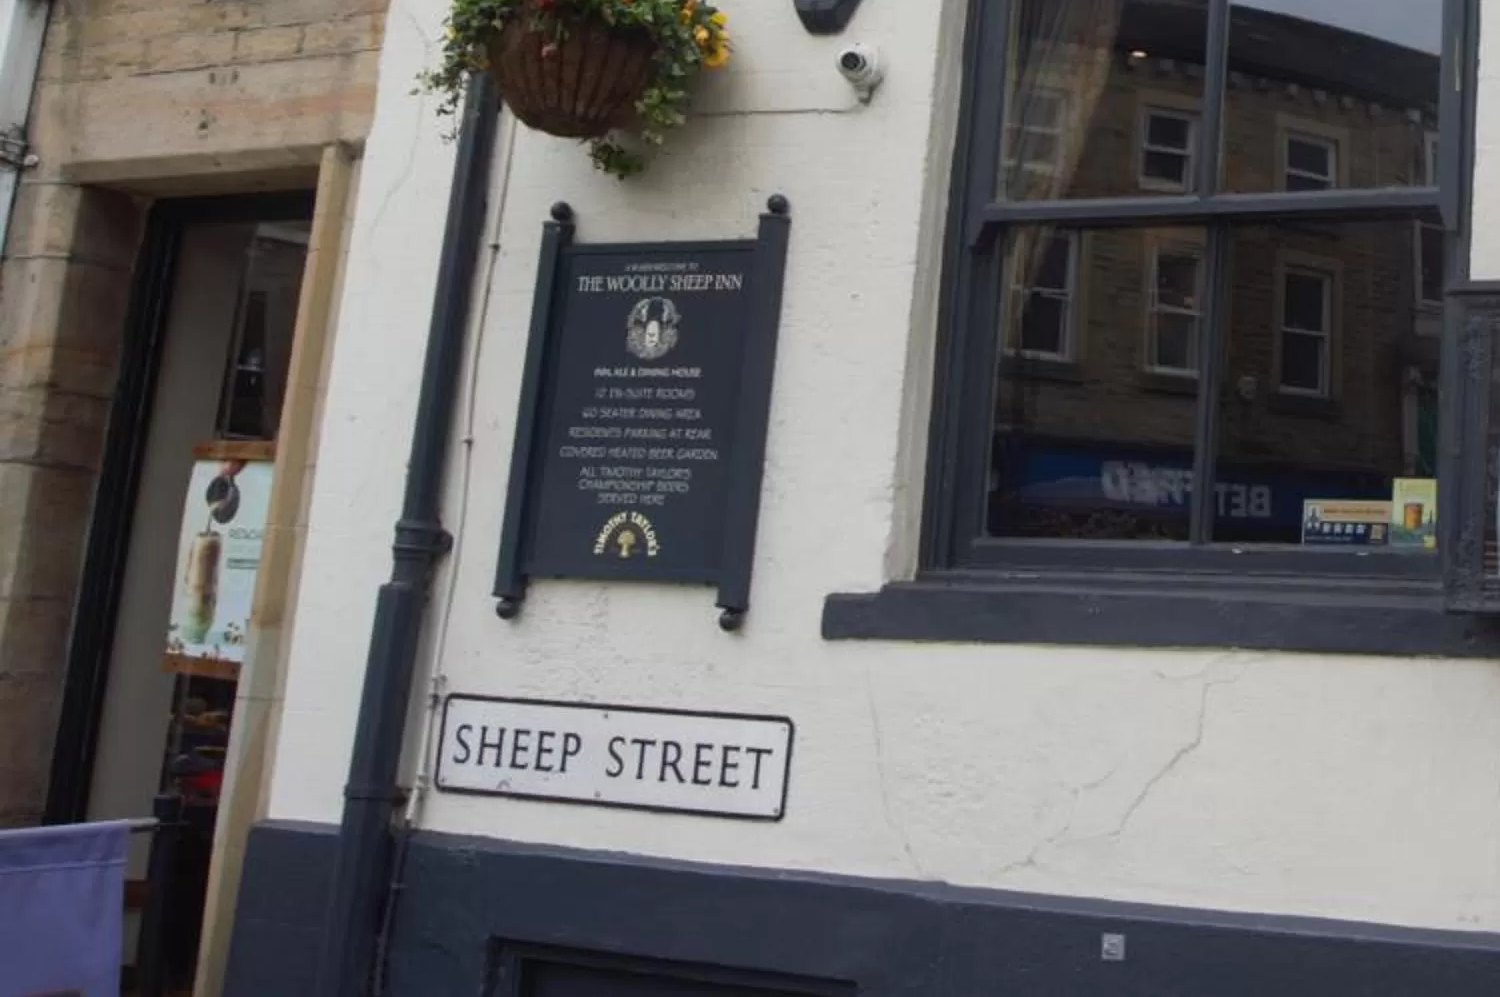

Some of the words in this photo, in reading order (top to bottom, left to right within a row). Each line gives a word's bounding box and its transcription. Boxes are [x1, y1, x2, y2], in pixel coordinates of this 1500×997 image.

[577, 274, 604, 292] THE
[606, 273, 668, 292] WOOLLY
[669, 273, 713, 291] SHEEP
[715, 272, 743, 290] INN
[593, 510, 629, 556] TIMOTHY
[451, 723, 583, 774] SHEEP
[604, 735, 774, 790] STREET
